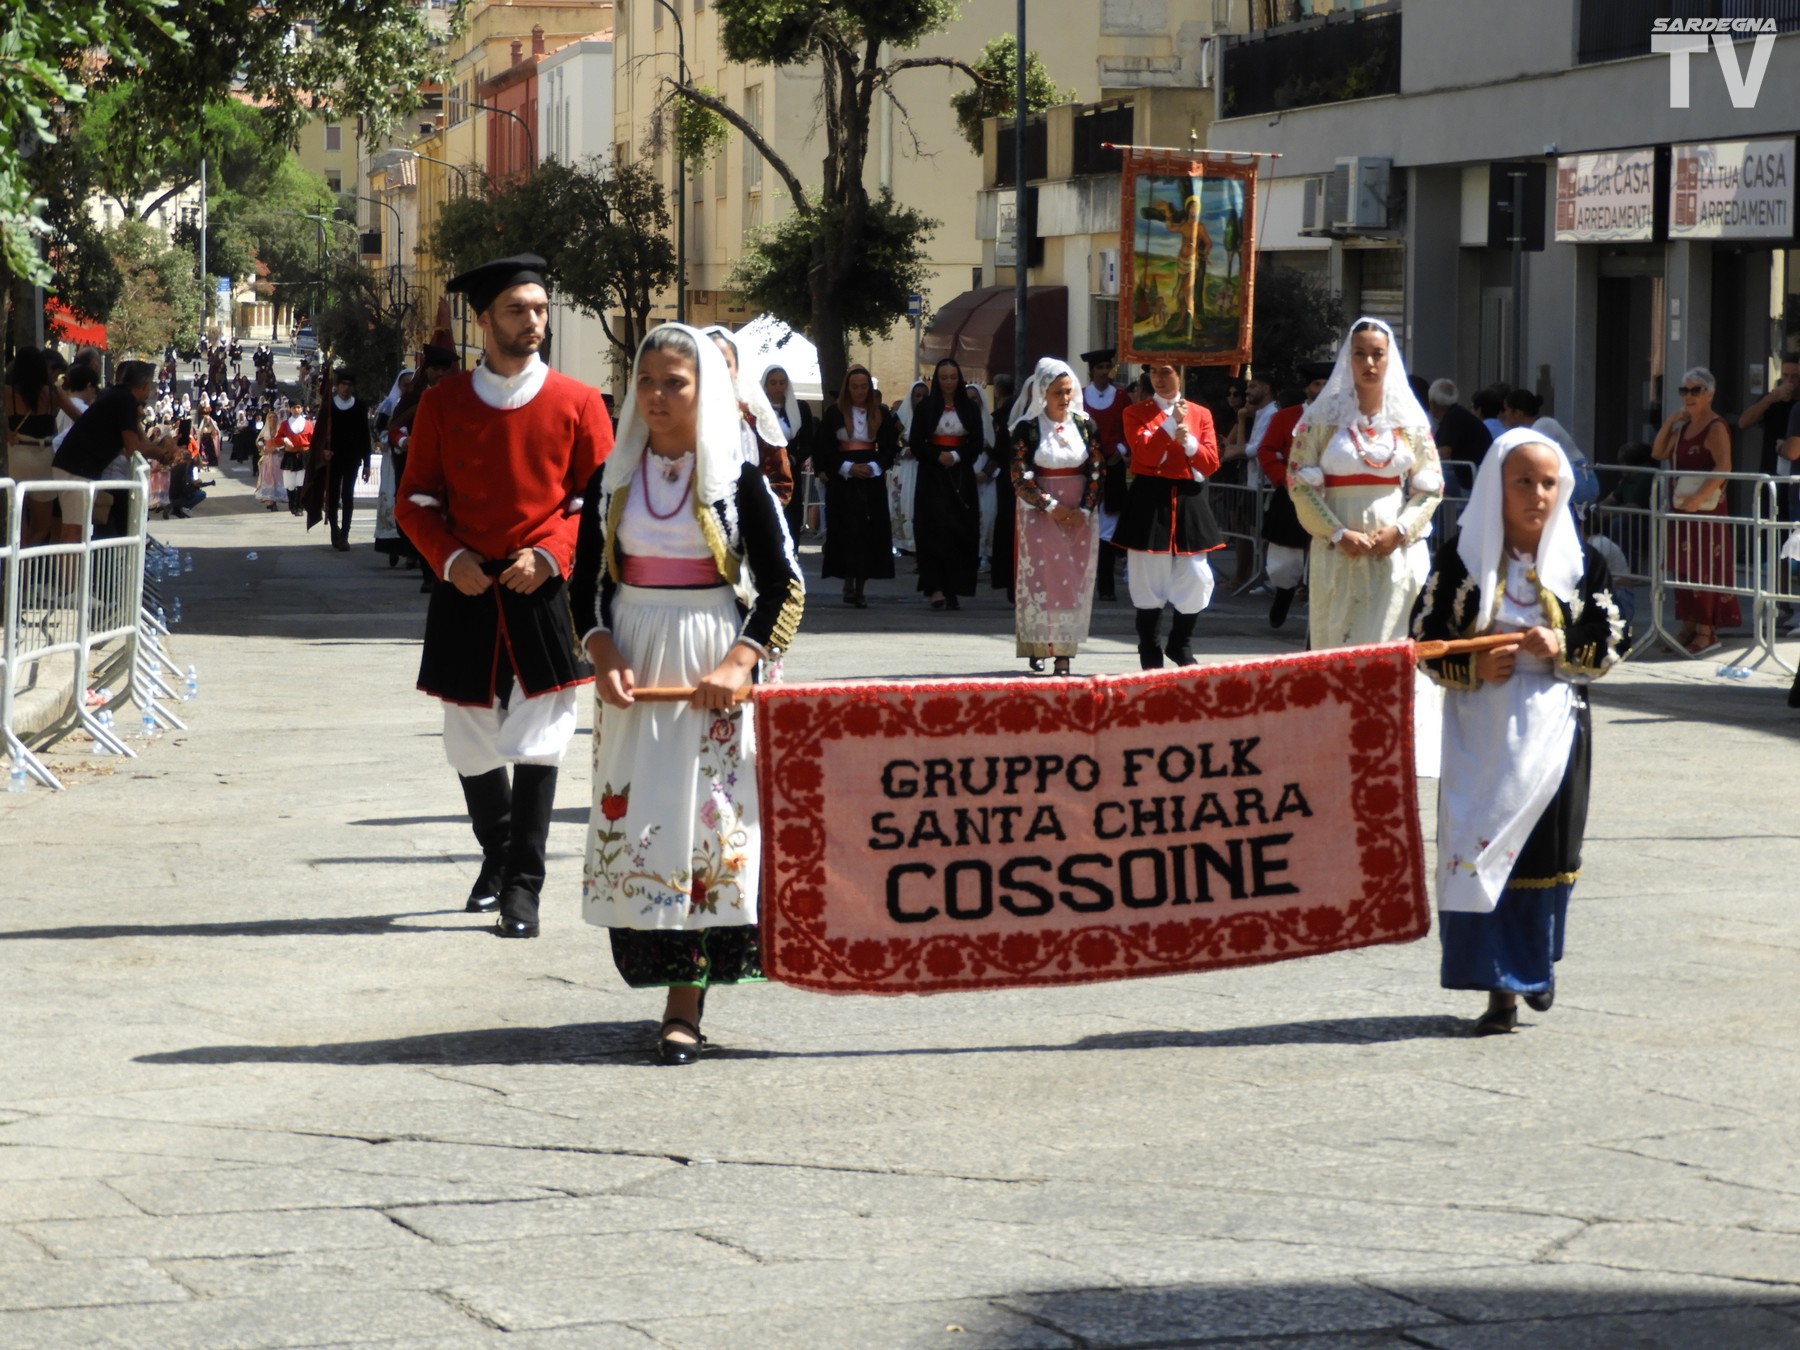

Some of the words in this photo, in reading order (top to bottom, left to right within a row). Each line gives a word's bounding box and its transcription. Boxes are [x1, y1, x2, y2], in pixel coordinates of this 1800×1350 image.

[1578, 175, 1590, 197] LA
[1593, 174, 1611, 196] TUA
[1614, 162, 1650, 195] CASA
[1700, 165, 1714, 189] LA
[1719, 165, 1739, 189] TUA
[1743, 153, 1787, 188] CASA
[1577, 205, 1651, 230] ARREDAMENTI
[1700, 200, 1787, 226] ARREDAMENTI
[880, 753, 1101, 801] GRUPPO
[1122, 736, 1262, 788] FOLK
[868, 803, 1067, 853] SANTA
[1093, 783, 1314, 840] CHIARA
[885, 832, 1301, 924] COSSOINE
